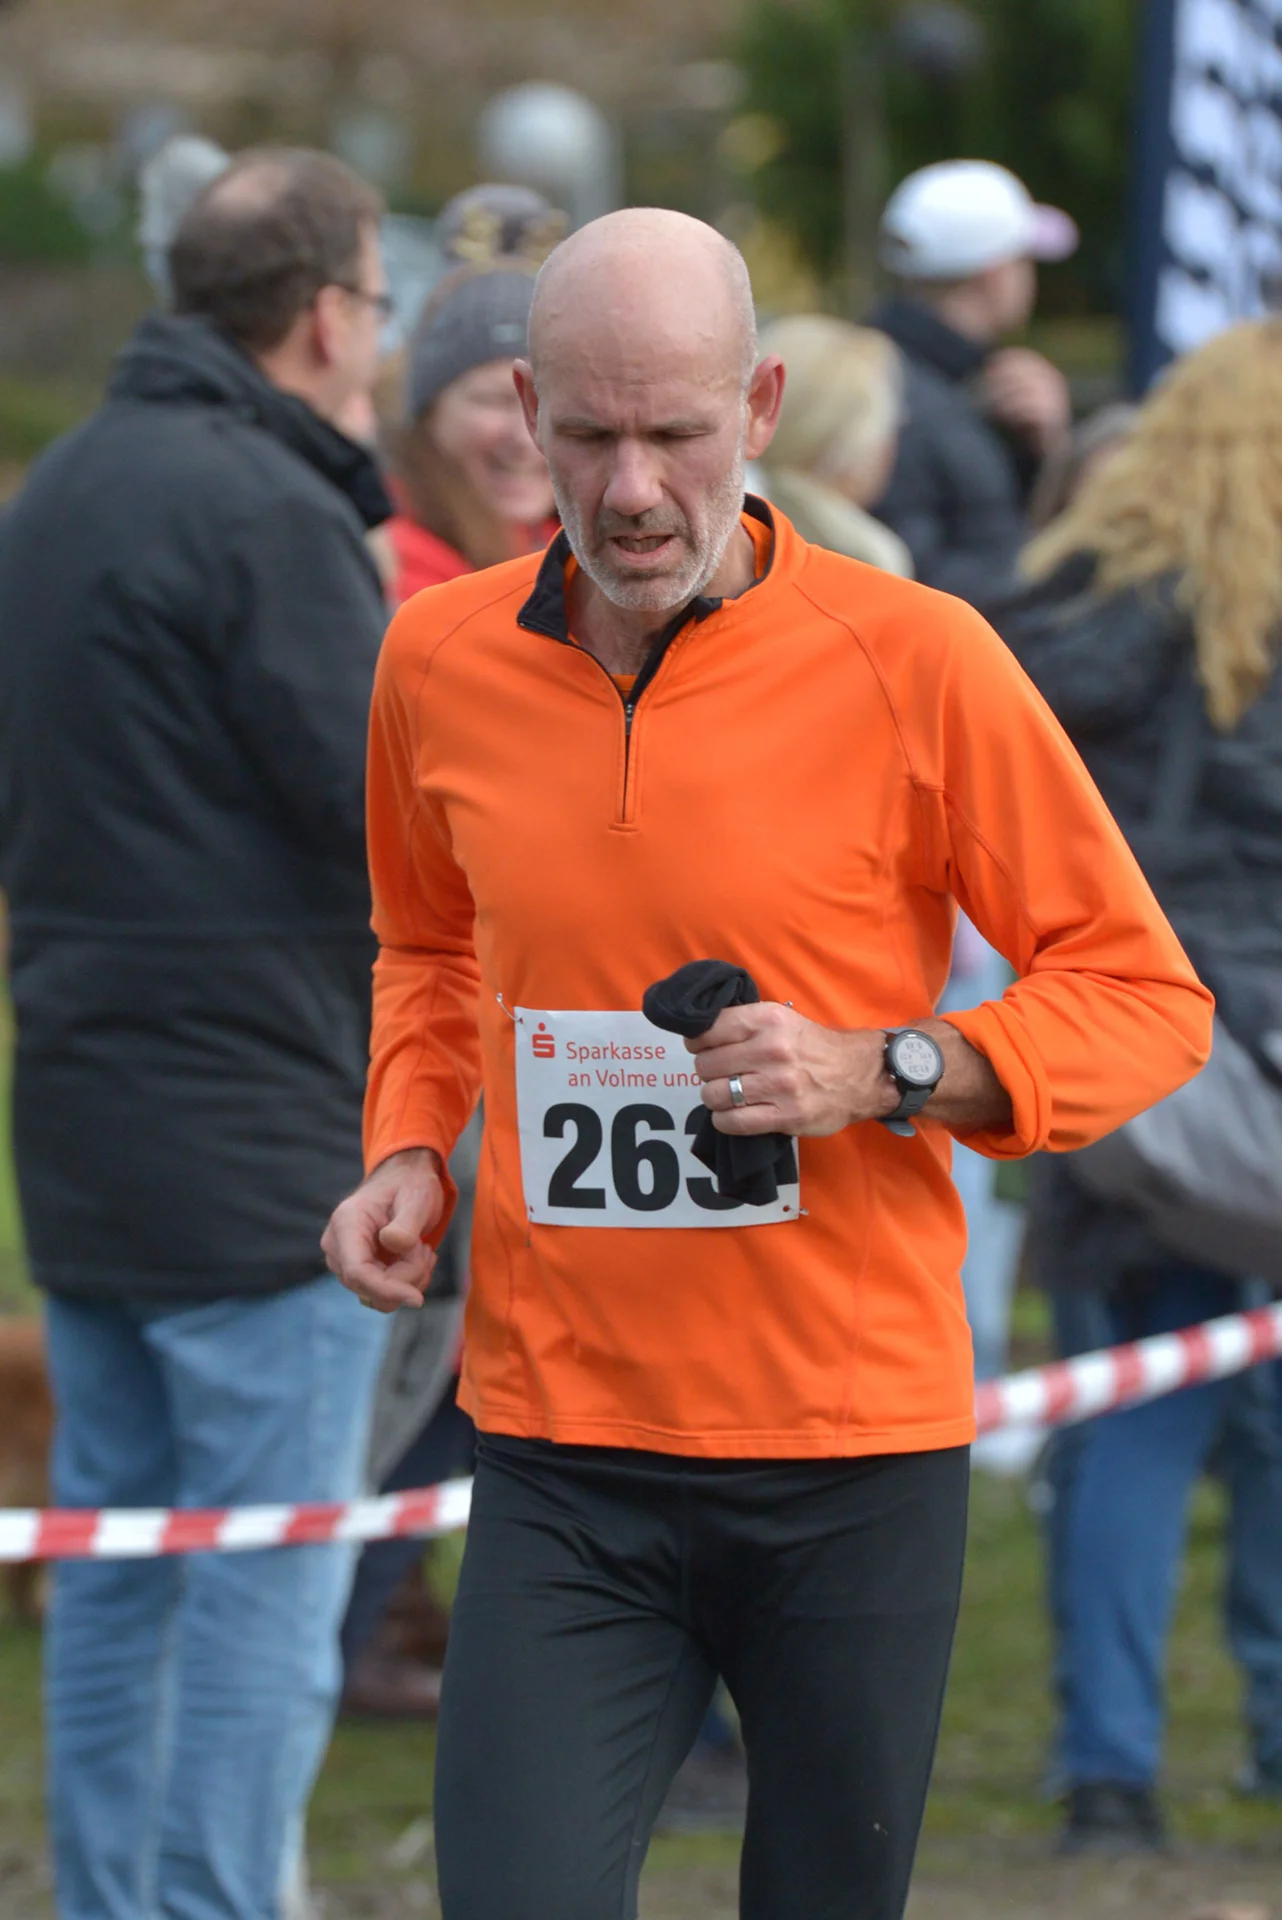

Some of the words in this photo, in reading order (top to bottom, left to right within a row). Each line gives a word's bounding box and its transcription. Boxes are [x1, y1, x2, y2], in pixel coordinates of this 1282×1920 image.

[566, 1041, 666, 1063] Sparkasse
[568, 1073, 591, 1087] an
[595, 1069, 657, 1087] Volme
